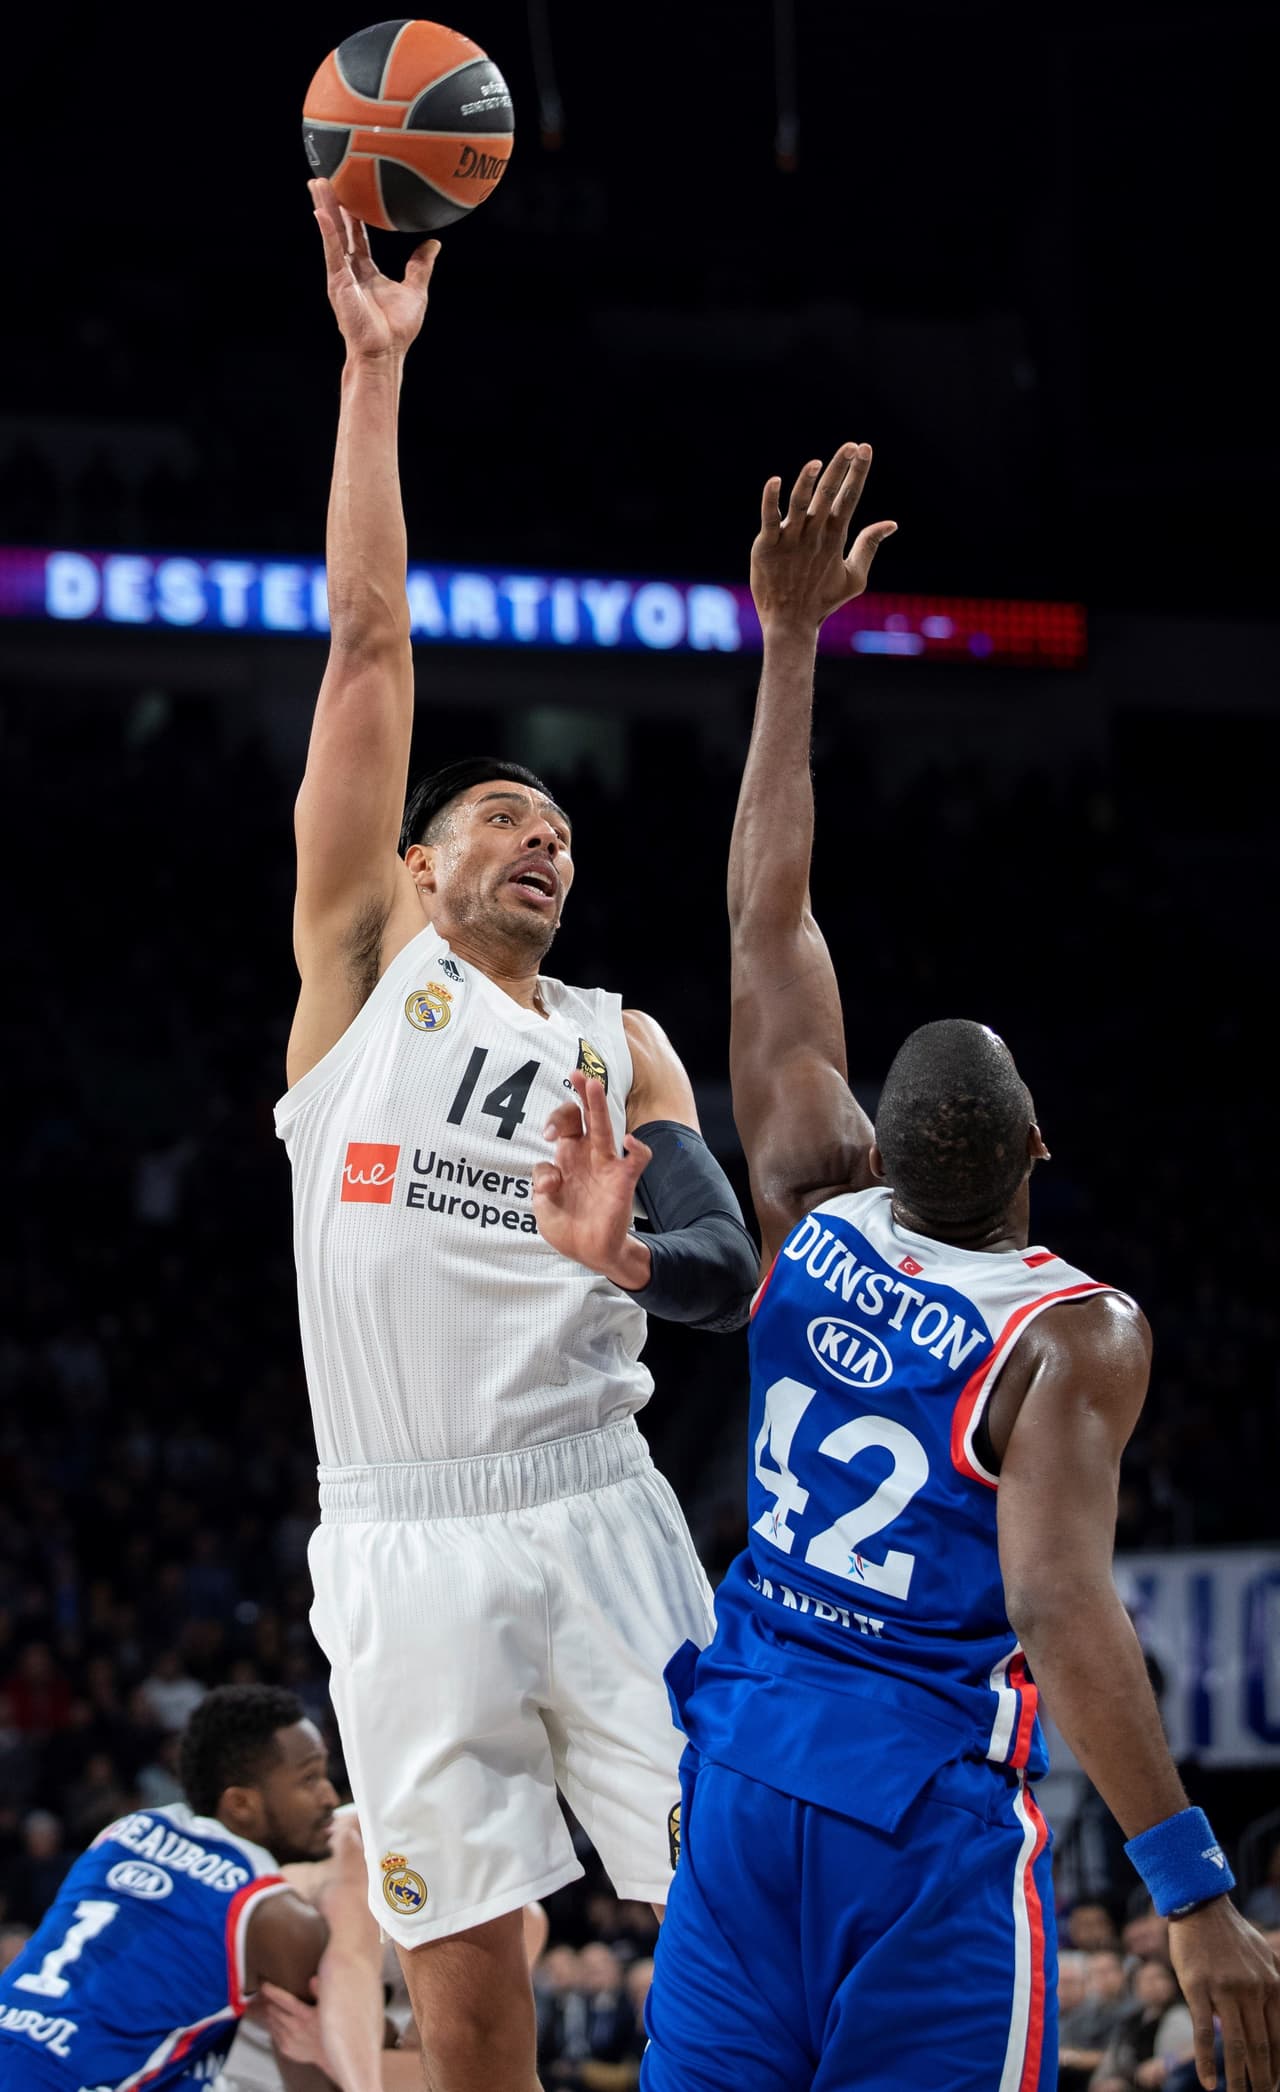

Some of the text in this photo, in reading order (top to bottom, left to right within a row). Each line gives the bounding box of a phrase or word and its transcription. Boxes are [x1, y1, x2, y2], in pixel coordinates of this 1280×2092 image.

[446, 1046, 541, 1141] 14
[405, 1181, 539, 1235] Europea
[412, 1148, 535, 1200] Univers
[784, 1215, 986, 1371] DUNSTON
[816, 1322, 877, 1383] KIA
[752, 1376, 930, 1601] 42
[115, 1865, 163, 1893] KIA
[12, 1899, 120, 1998] 1
